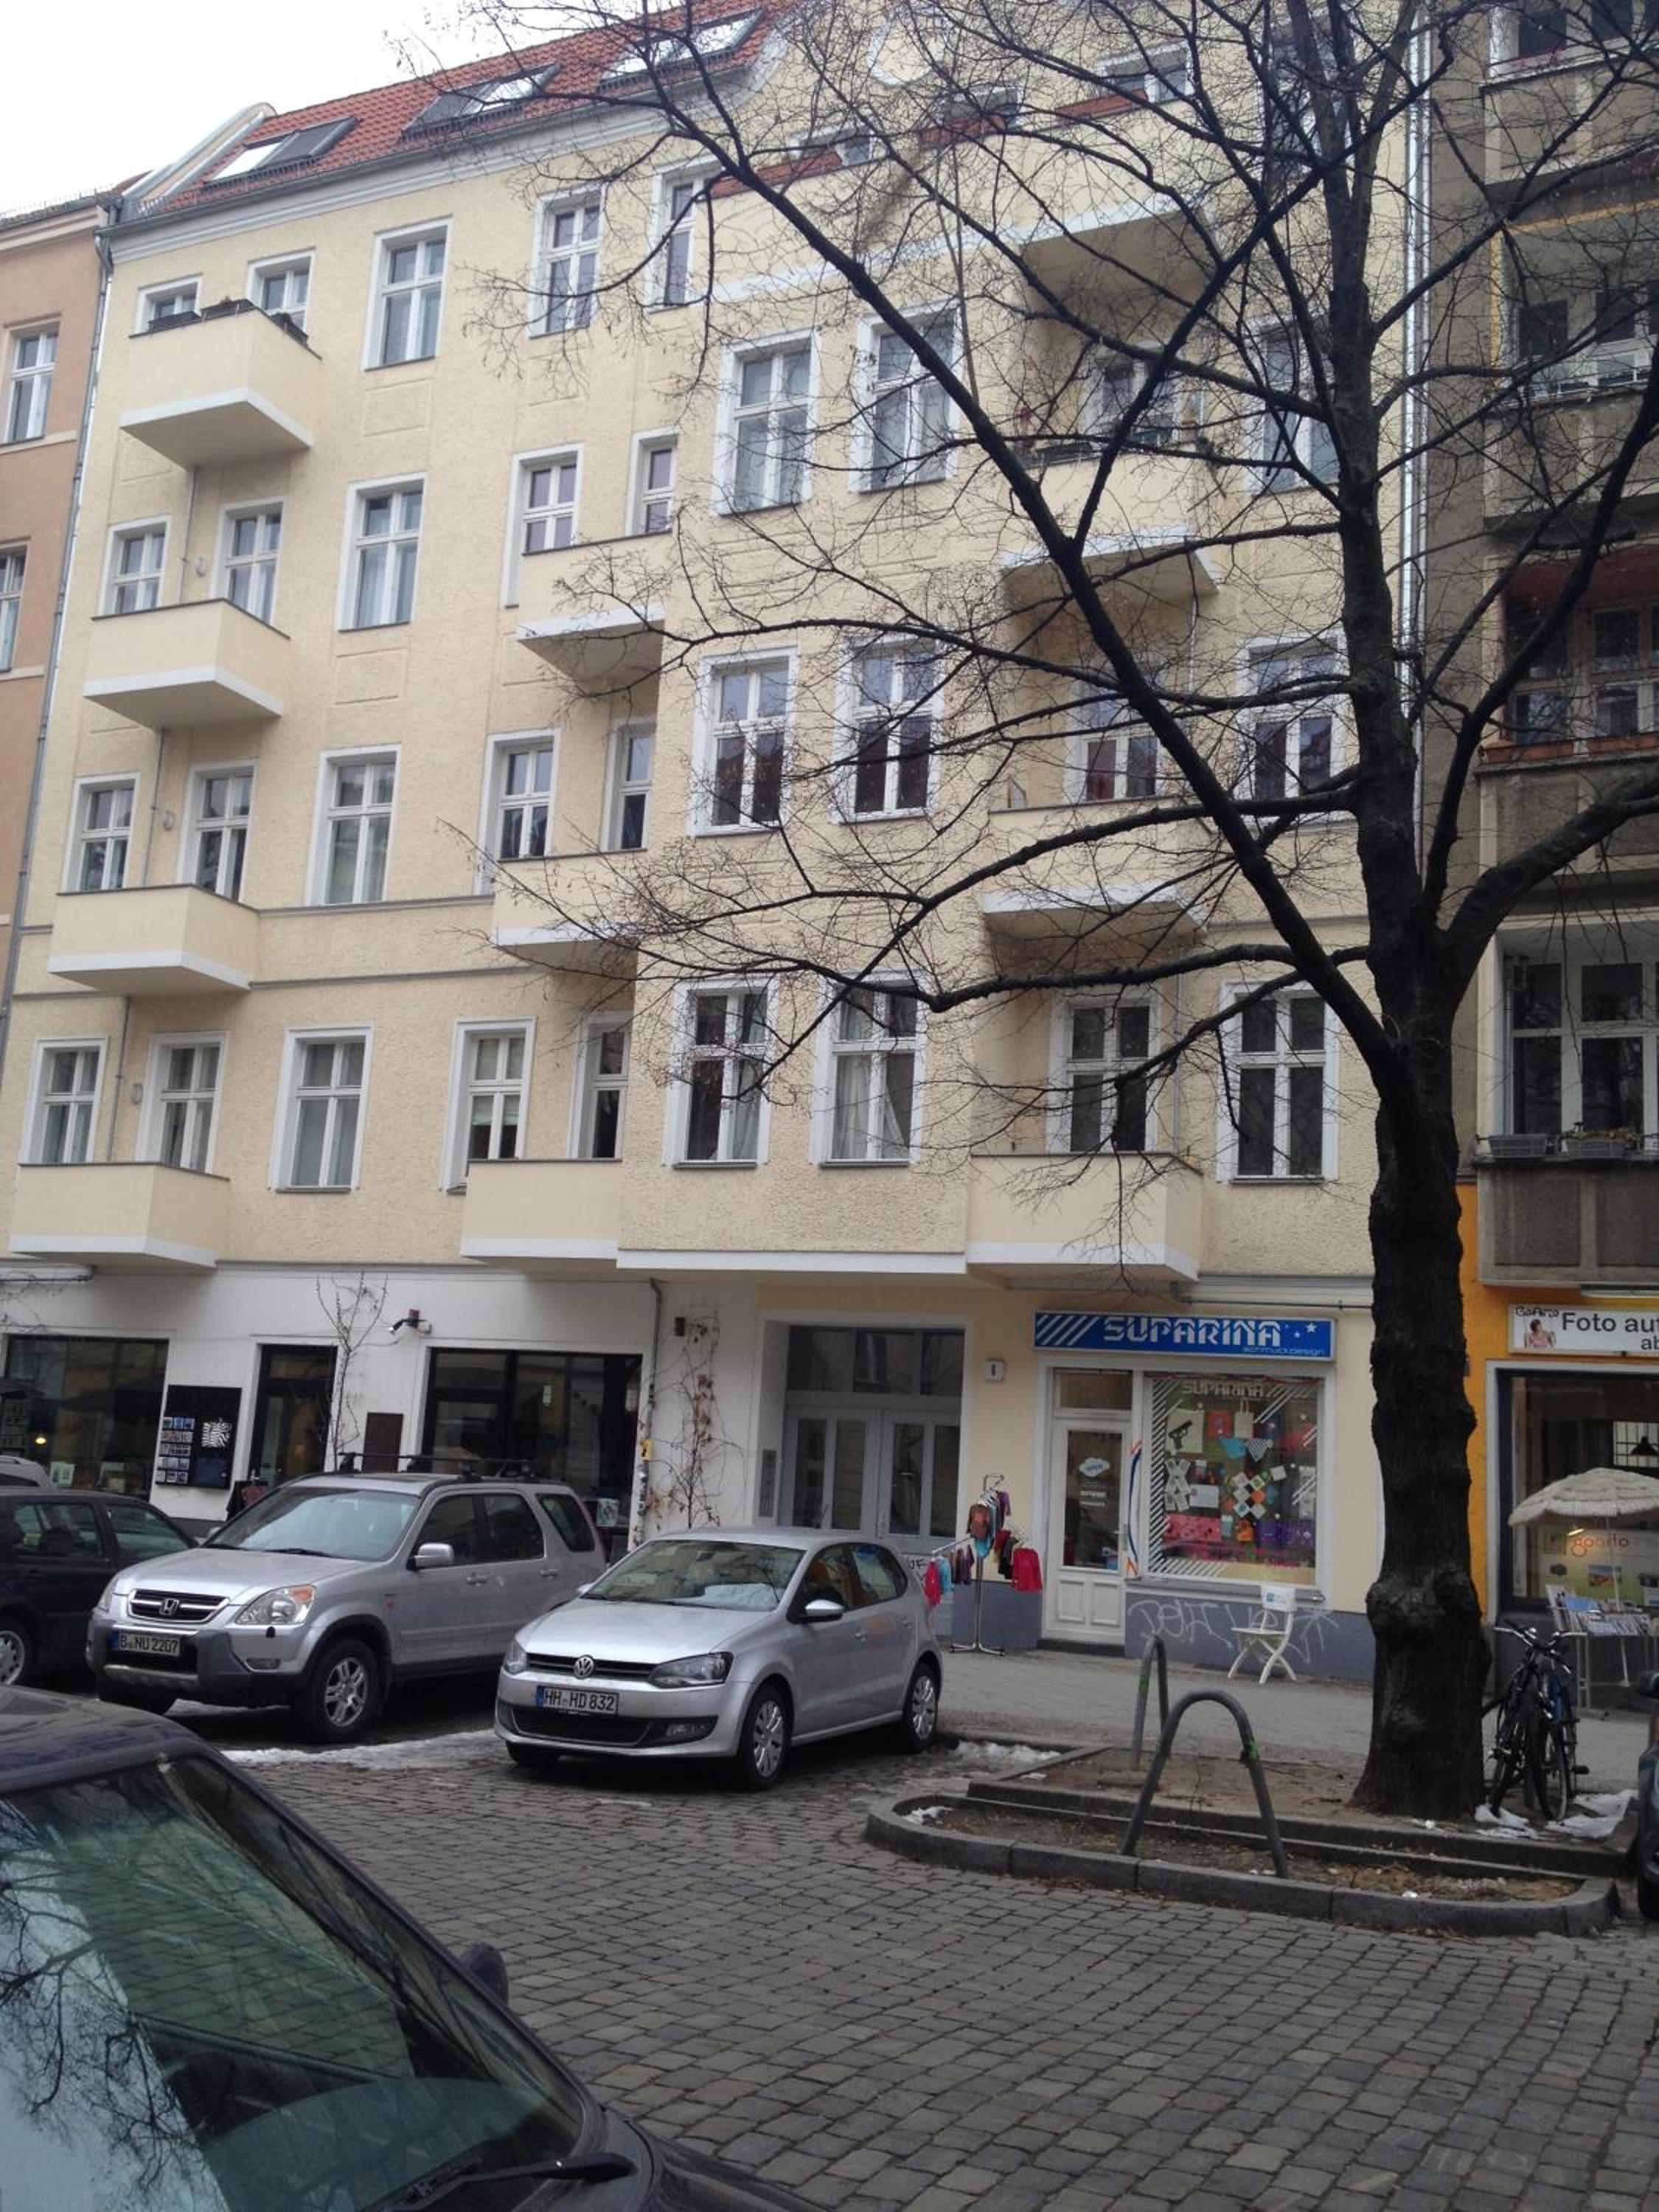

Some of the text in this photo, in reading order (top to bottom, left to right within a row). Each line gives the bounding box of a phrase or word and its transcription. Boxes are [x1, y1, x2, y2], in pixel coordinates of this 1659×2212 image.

[1103, 1316, 1281, 1346] SUPARINA
[1562, 1312, 1617, 1332] Foto
[120, 1635, 128, 1648] B
[589, 1694, 615, 1711] 832
